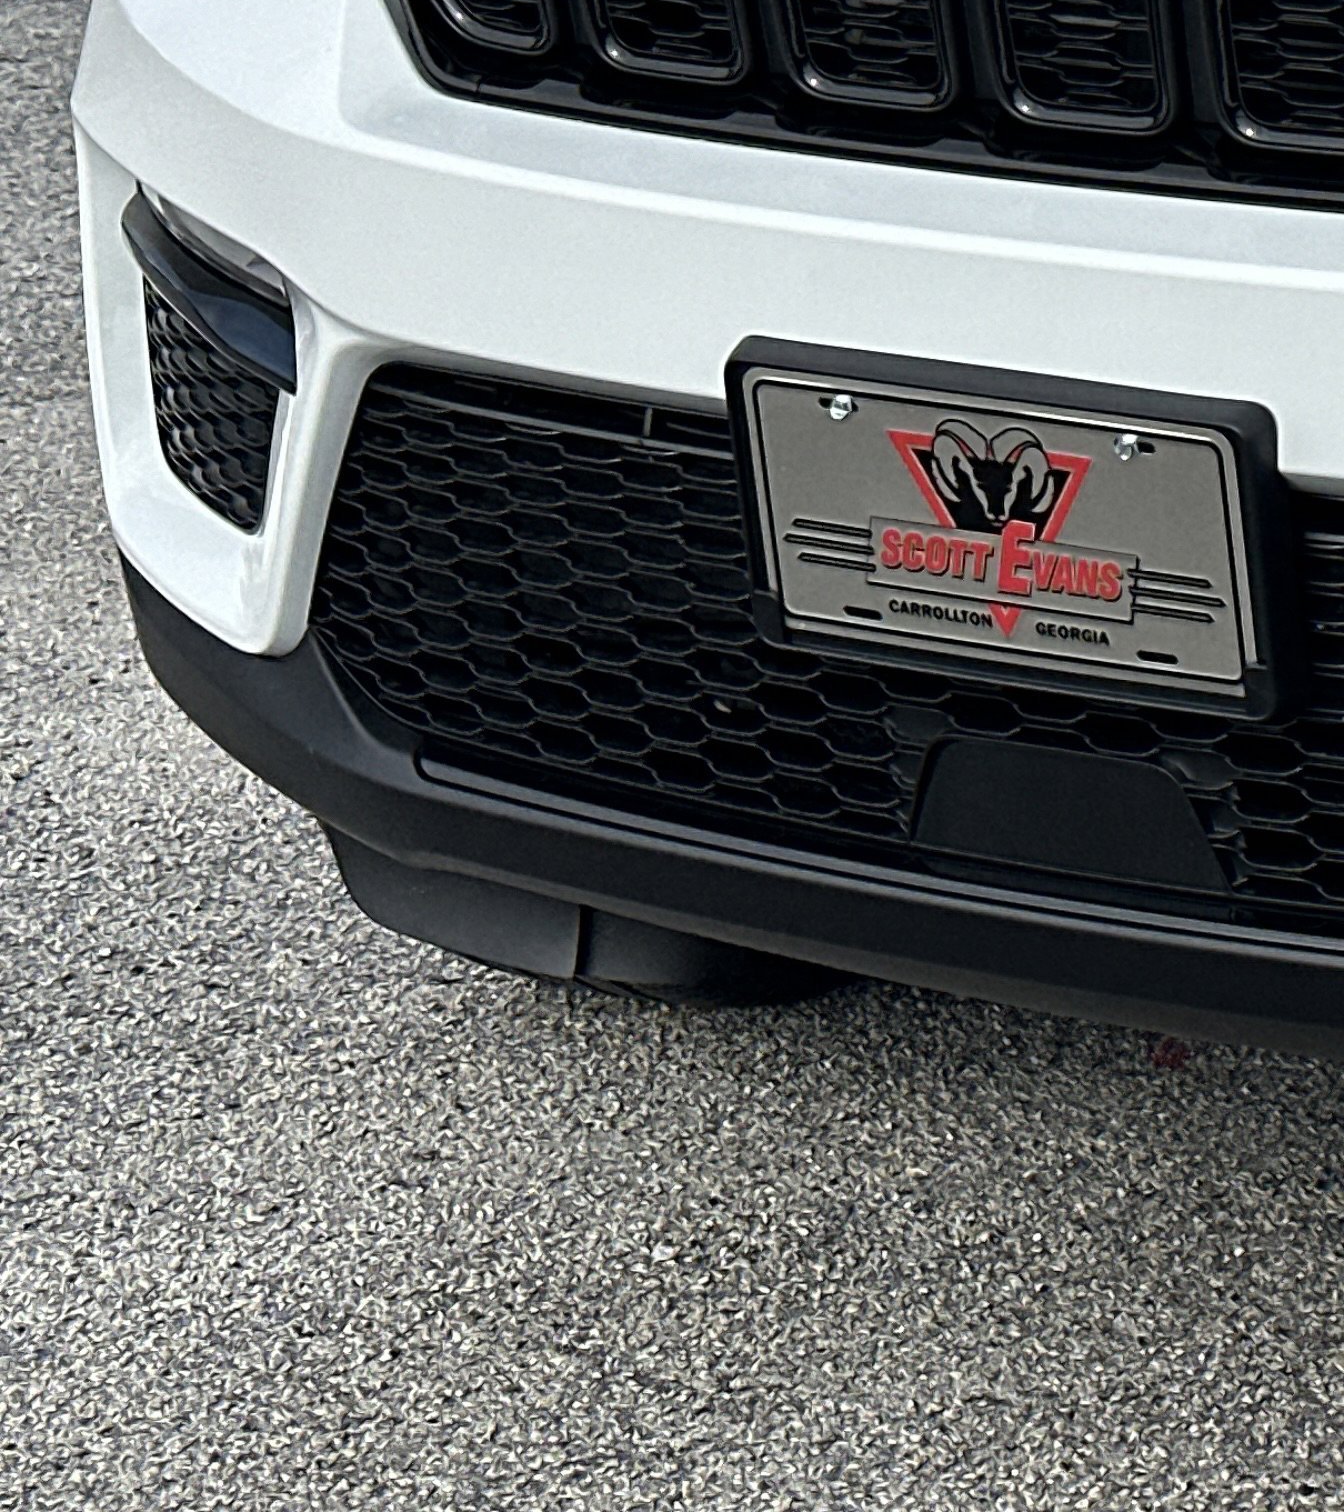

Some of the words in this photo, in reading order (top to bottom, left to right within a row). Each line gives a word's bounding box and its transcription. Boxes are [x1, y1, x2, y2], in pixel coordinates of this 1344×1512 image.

[880, 528, 995, 582] SCOTT
[997, 520, 1123, 602] EVANS
[888, 599, 993, 630] CARROLLTON
[1035, 622, 1111, 646] GEORGIA
